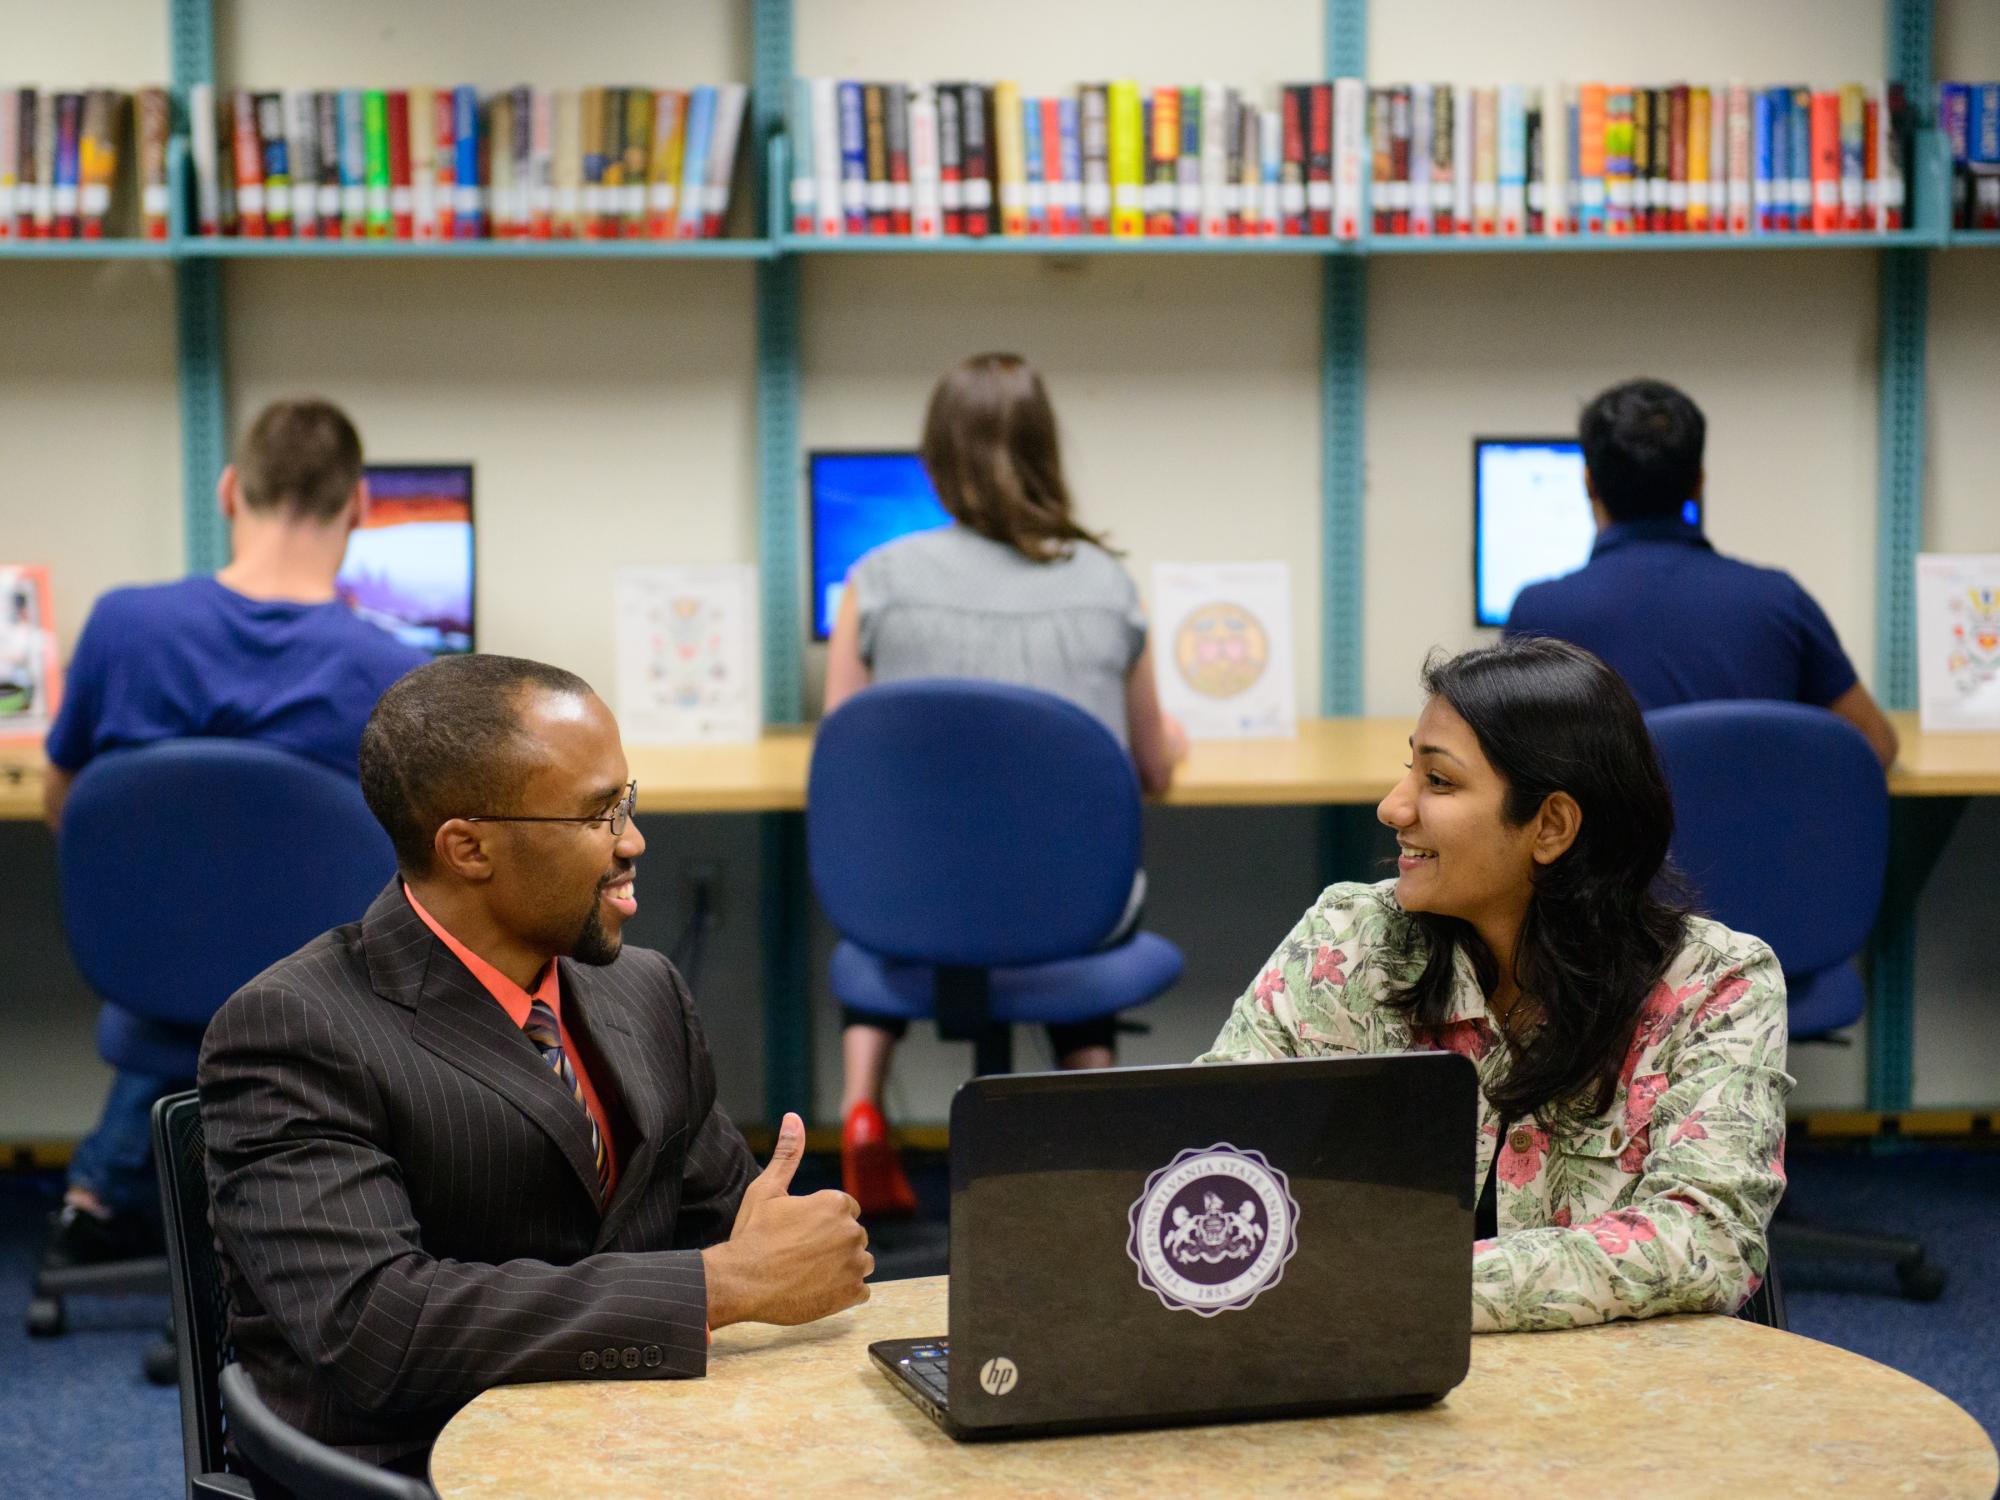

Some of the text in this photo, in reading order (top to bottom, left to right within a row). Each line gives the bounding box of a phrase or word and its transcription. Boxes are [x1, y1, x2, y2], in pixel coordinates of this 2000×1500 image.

[1146, 1161, 1283, 1289] THE PENNSYLVANIA STATE UNIVERSITY
[1197, 1285, 1232, 1299] 1855
[986, 1357, 1013, 1395] hp
